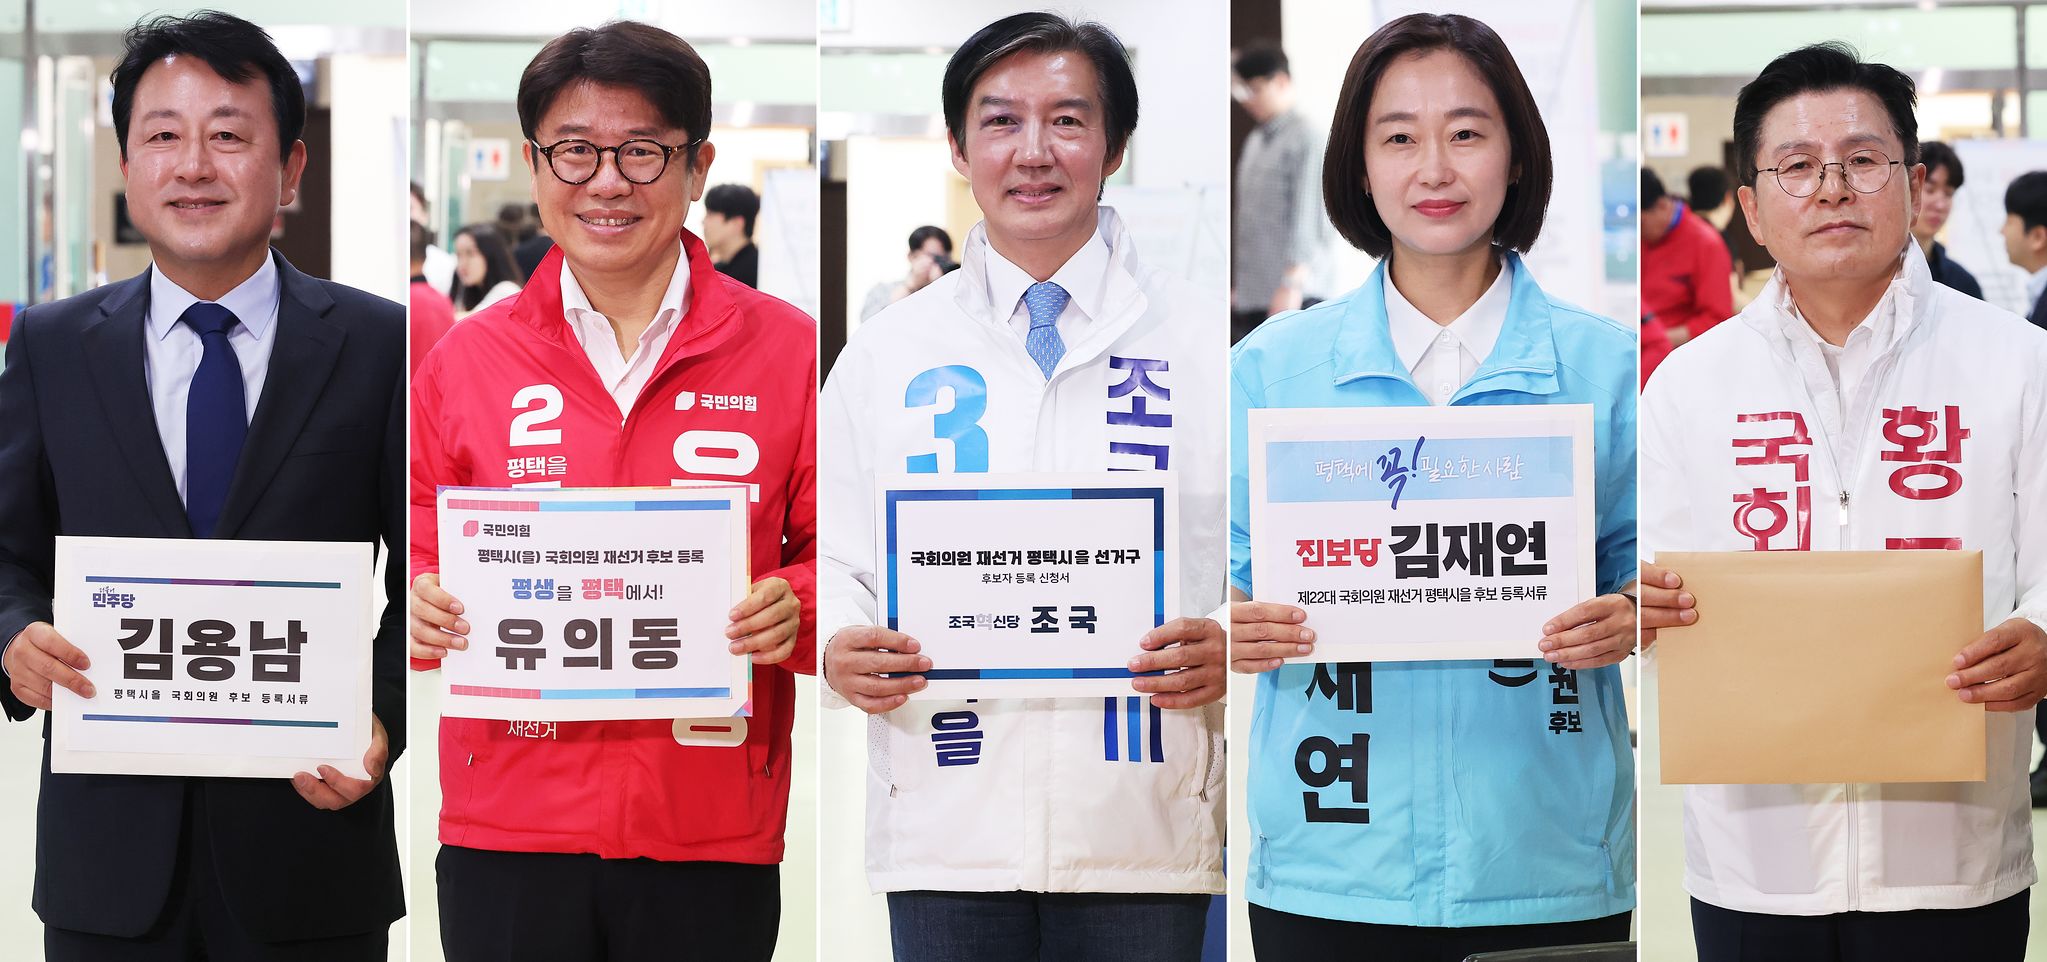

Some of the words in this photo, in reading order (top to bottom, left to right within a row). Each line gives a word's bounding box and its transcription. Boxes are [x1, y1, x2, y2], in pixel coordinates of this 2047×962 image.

[700, 393, 757, 412] 국민의힘
[509, 383, 564, 447] 2
[904, 364, 989, 474] 3
[506, 454, 567, 479] 평택을
[1315, 458, 1373, 484] 평택에
[1376, 436, 1426, 511] 꼭!
[1420, 455, 1480, 484] 필요한
[1482, 455, 1525, 482] 사람
[1880, 405, 1971, 550] 황
[483, 523, 531, 538] 국민의힘
[477, 549, 541, 565] 평택시(을)
[545, 550, 600, 565] 국회의원
[603, 550, 644, 565] 재선거
[646, 550, 673, 564] 후보
[677, 550, 704, 564] 등록
[910, 551, 972, 566] 국회의원
[976, 550, 1022, 566] 재선거
[1026, 549, 1090, 566] 평택시을
[1094, 549, 1141, 565] 선거구
[1296, 538, 1382, 567] 진보당
[1388, 521, 1548, 580] 김재연
[981, 573, 1012, 584] 후보자
[1015, 573, 1036, 584] 등록
[1039, 572, 1070, 584] 신청서
[511, 578, 572, 601] 평생을
[581, 578, 664, 601] 평택에서!
[1297, 589, 1336, 605] 제22대
[1338, 589, 1385, 604] 국회의원
[1387, 588, 1423, 604] 재선거
[1425, 587, 1472, 603] 평택시을
[1474, 586, 1498, 602] 후보
[1501, 585, 1548, 601] 등록서류
[92, 593, 136, 609] 민주당
[948, 613, 1020, 631] 조국혁신당
[116, 618, 308, 682] 김용남
[114, 689, 161, 700] 평택시을
[171, 690, 218, 702] 국회의원
[229, 692, 251, 703] 후보
[261, 693, 309, 705] 등록서류
[1549, 711, 1582, 734] 후보
